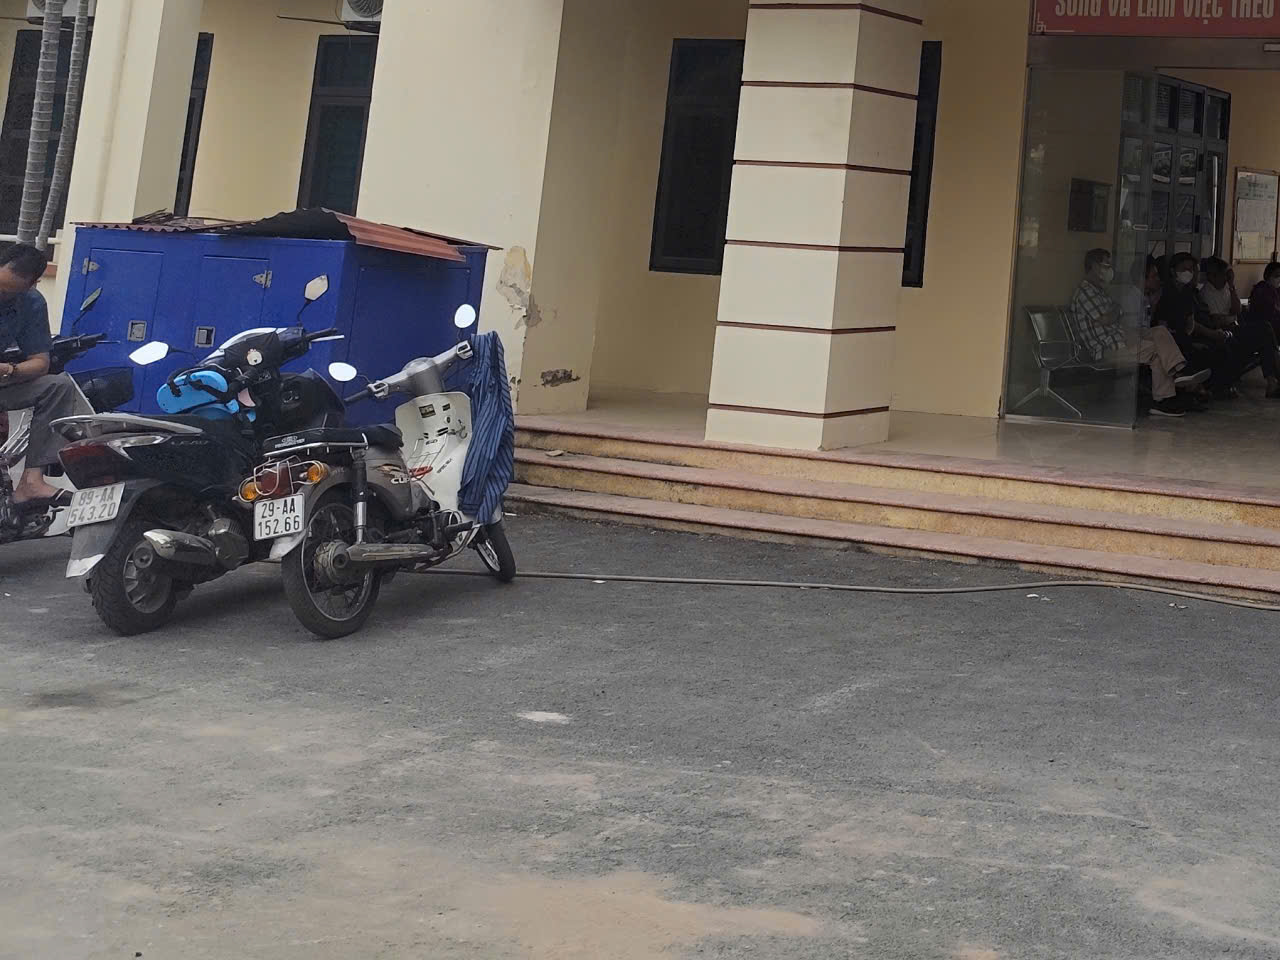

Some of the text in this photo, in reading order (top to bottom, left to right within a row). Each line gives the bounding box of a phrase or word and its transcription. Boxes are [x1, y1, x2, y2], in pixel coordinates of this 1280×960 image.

[79, 486, 117, 507] 89-AA
[69, 502, 117, 525] 543.20
[261, 497, 296, 519] 29-AA
[258, 515, 300, 538] 152.66
